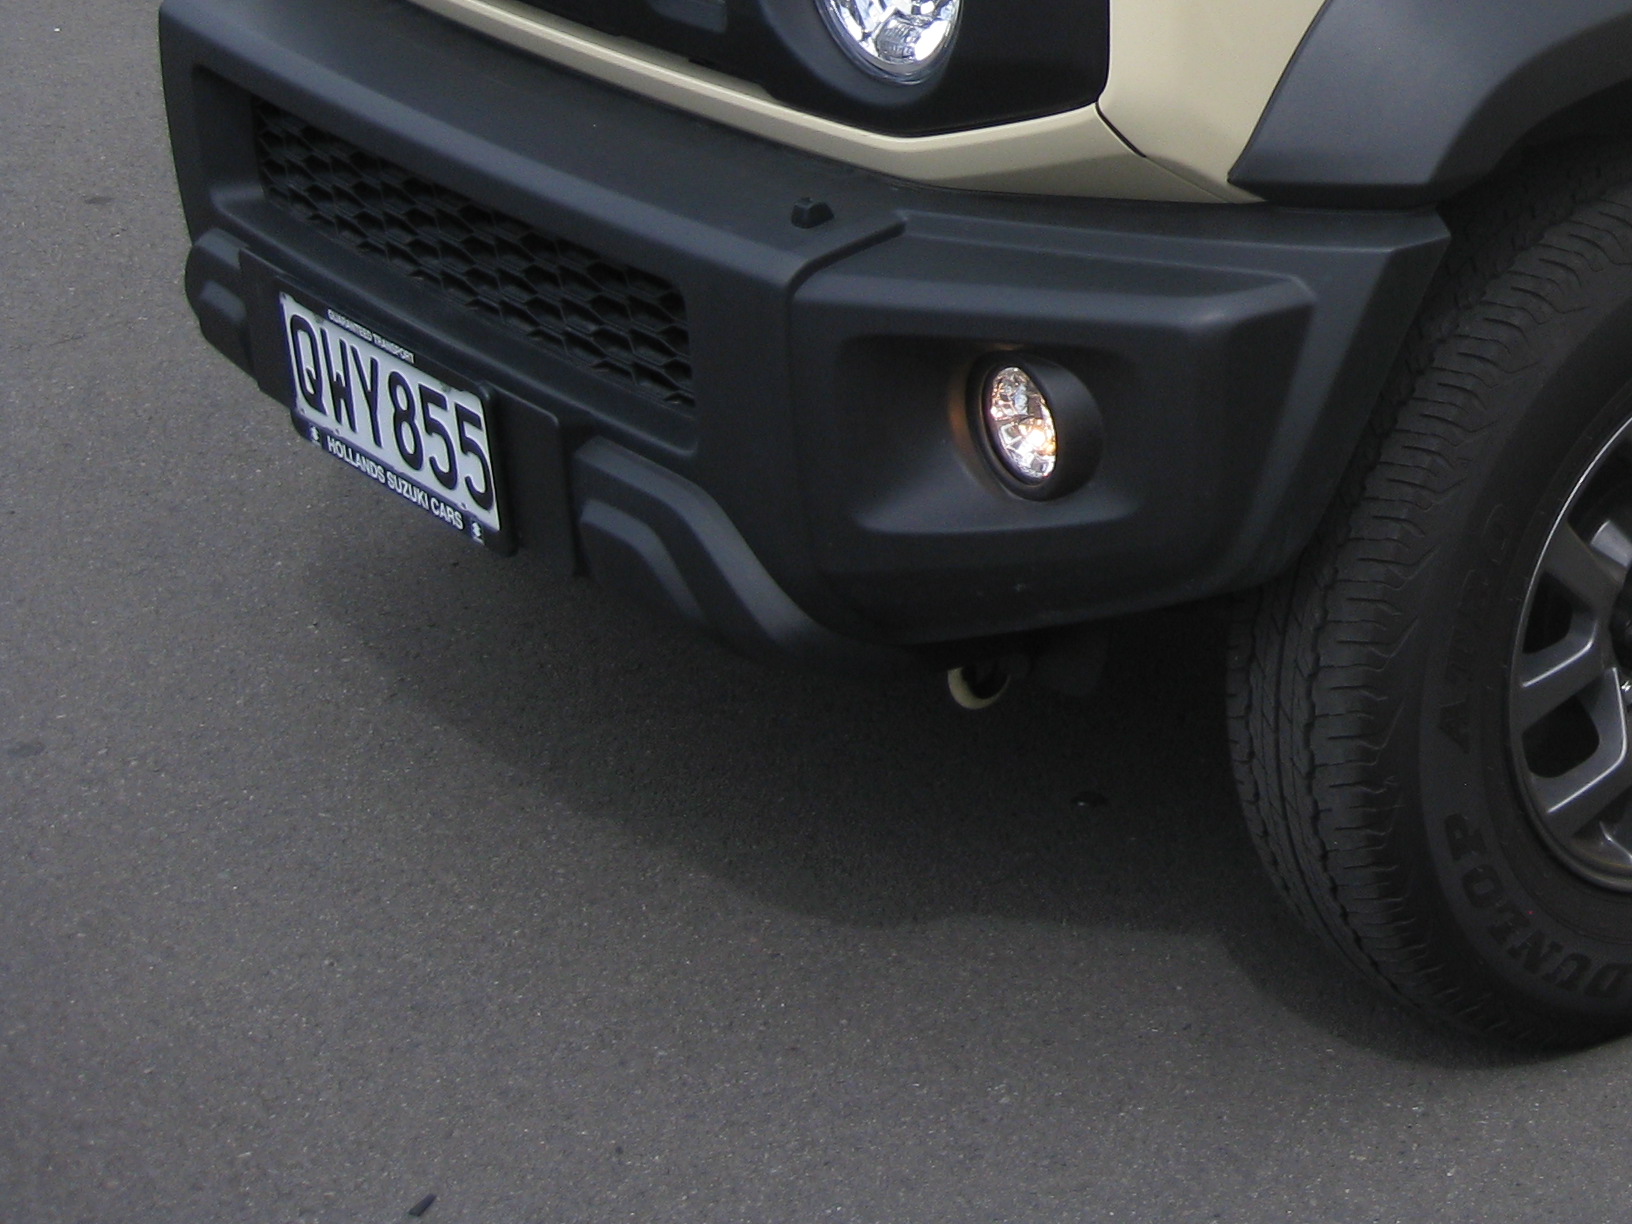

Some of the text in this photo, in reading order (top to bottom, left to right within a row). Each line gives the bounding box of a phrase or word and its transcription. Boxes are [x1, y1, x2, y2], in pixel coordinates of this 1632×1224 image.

[290, 313, 494, 512] QWY855
[326, 434, 465, 530] HOLLANDS SUZUKI CARS
